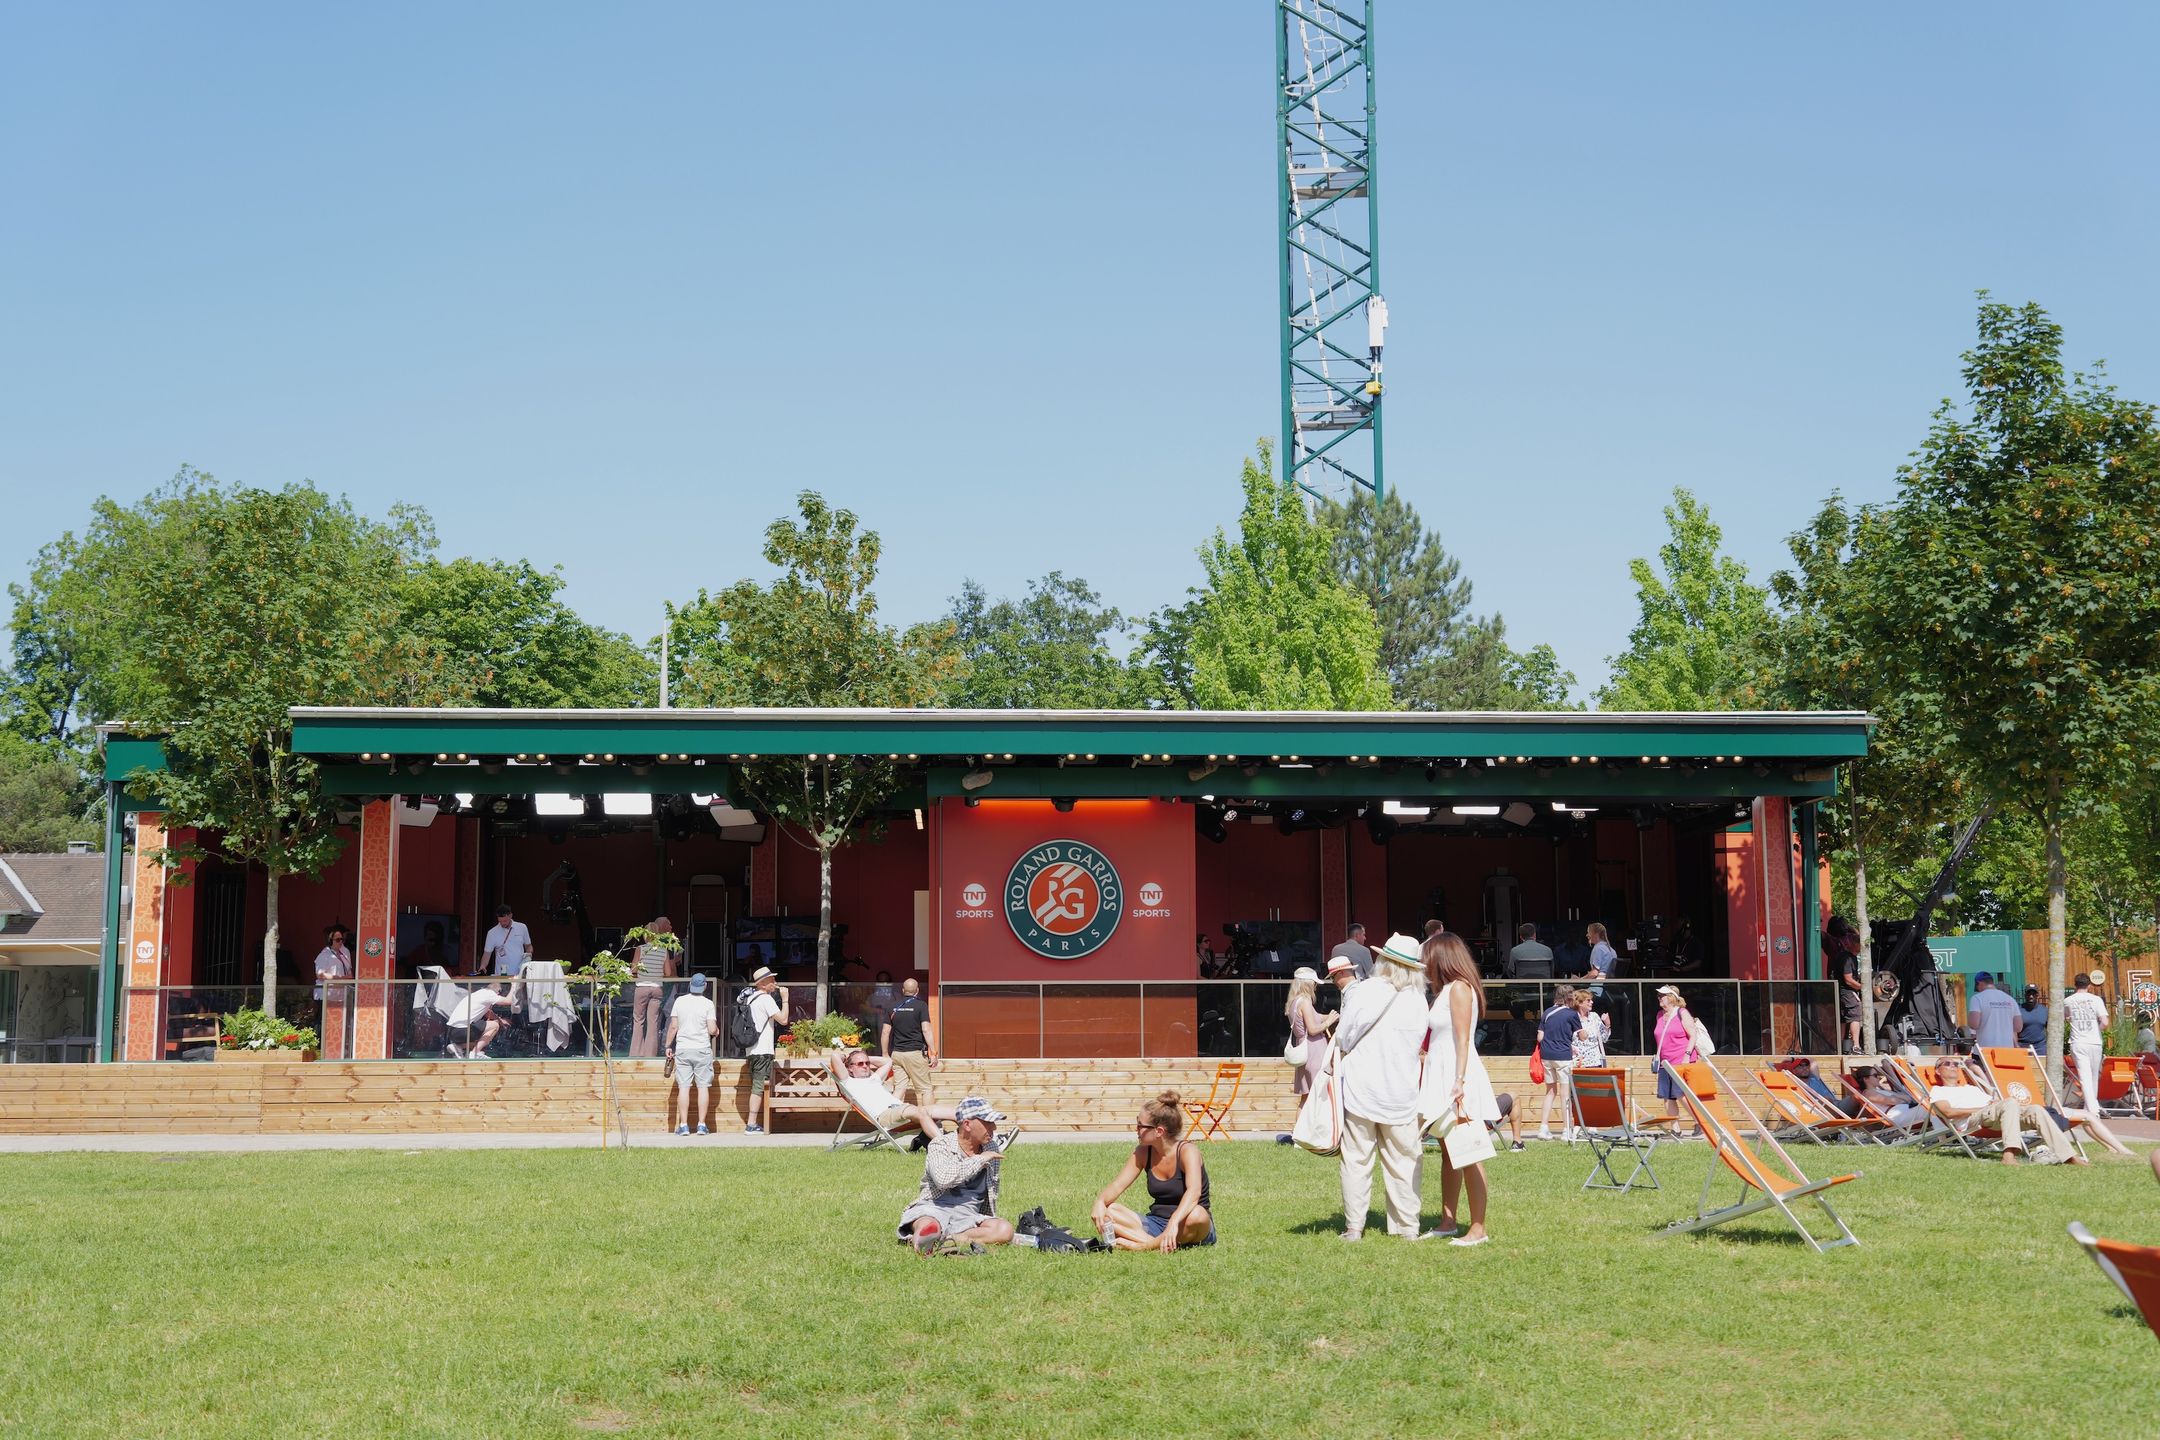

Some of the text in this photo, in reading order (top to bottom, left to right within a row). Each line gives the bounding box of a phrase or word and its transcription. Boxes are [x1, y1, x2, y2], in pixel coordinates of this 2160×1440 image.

[1011, 846, 1117, 911] ROLAND GARROS
[956, 909, 994, 918] SPORTS
[1132, 908, 1171, 917] SPORTS
[1028, 928, 1100, 951] PARIS
[1926, 946, 1957, 971] RT
